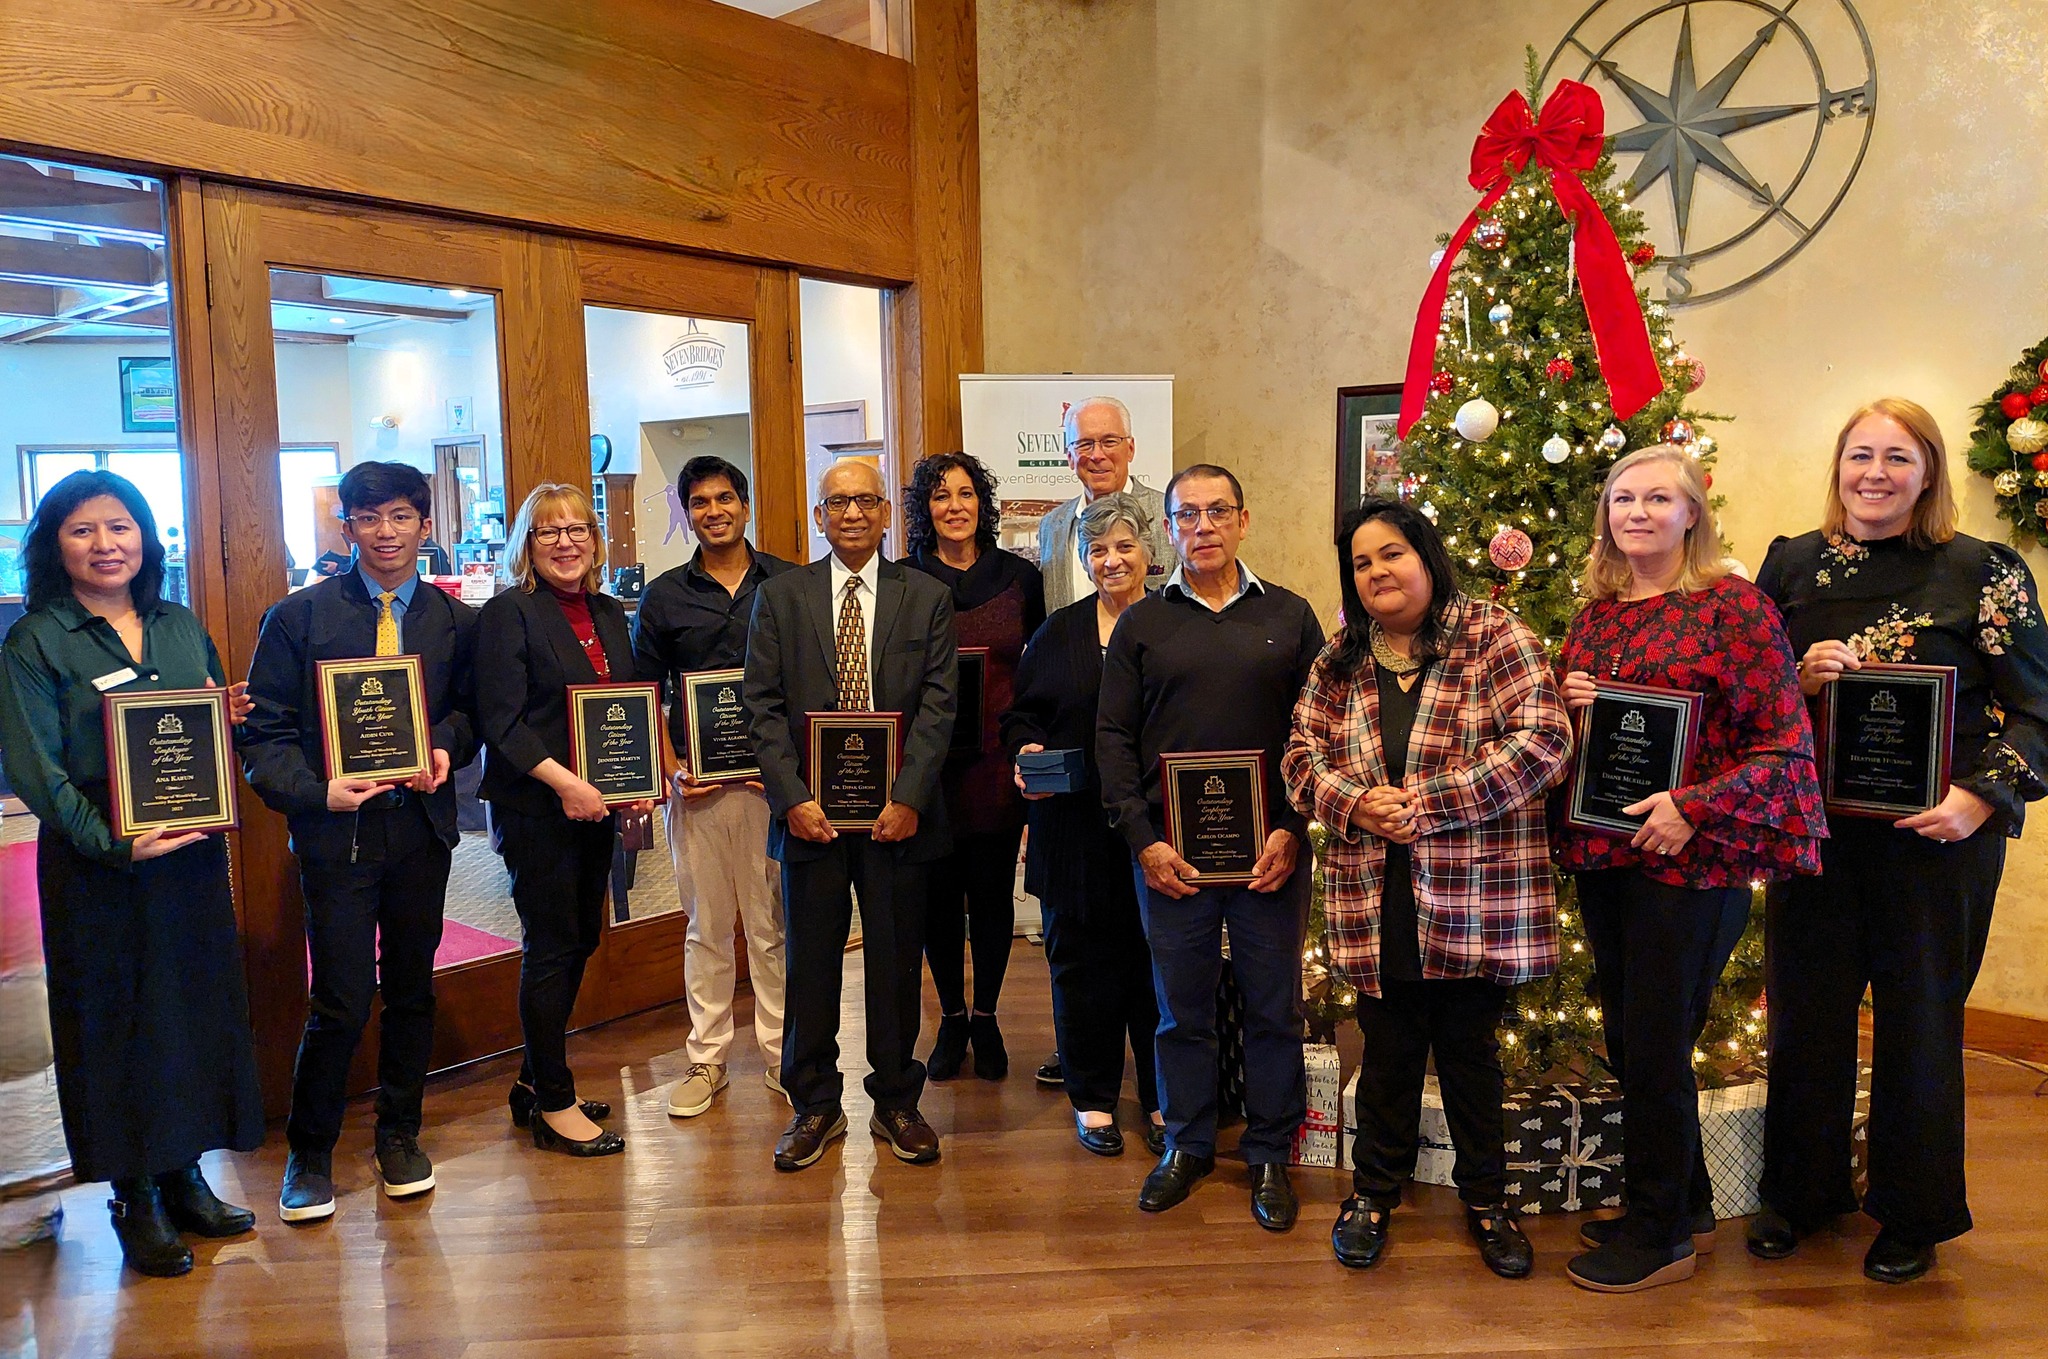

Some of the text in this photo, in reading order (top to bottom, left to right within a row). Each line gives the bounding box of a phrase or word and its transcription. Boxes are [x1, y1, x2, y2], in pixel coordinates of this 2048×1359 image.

[664, 345, 725, 375] SEVENBRIDGES
[354, 697, 392, 707] Outstanding
[352, 707, 373, 716] Youth
[712, 705, 743, 713] Outstanding
[356, 715, 365, 723] of
[377, 713, 394, 722] Year
[600, 723, 633, 731] Outstanding
[149, 736, 193, 746] Outstanding
[602, 740, 610, 748] of
[619, 739, 633, 747] Year
[1609, 732, 1652, 747] Outstanding
[154, 747, 190, 756] Employee
[1617, 744, 1642, 753] Citizen
[151, 755, 194, 765] of the Year
[836, 753, 870, 761] Outstanding
[1608, 752, 1650, 765] of the Year
[1602, 772, 1621, 781] DIANE
[1197, 798, 1234, 807] Outstanding
[1201, 807, 1231, 815] Employee
[1199, 814, 1208, 823] of
[1218, 814, 1234, 822] Year
